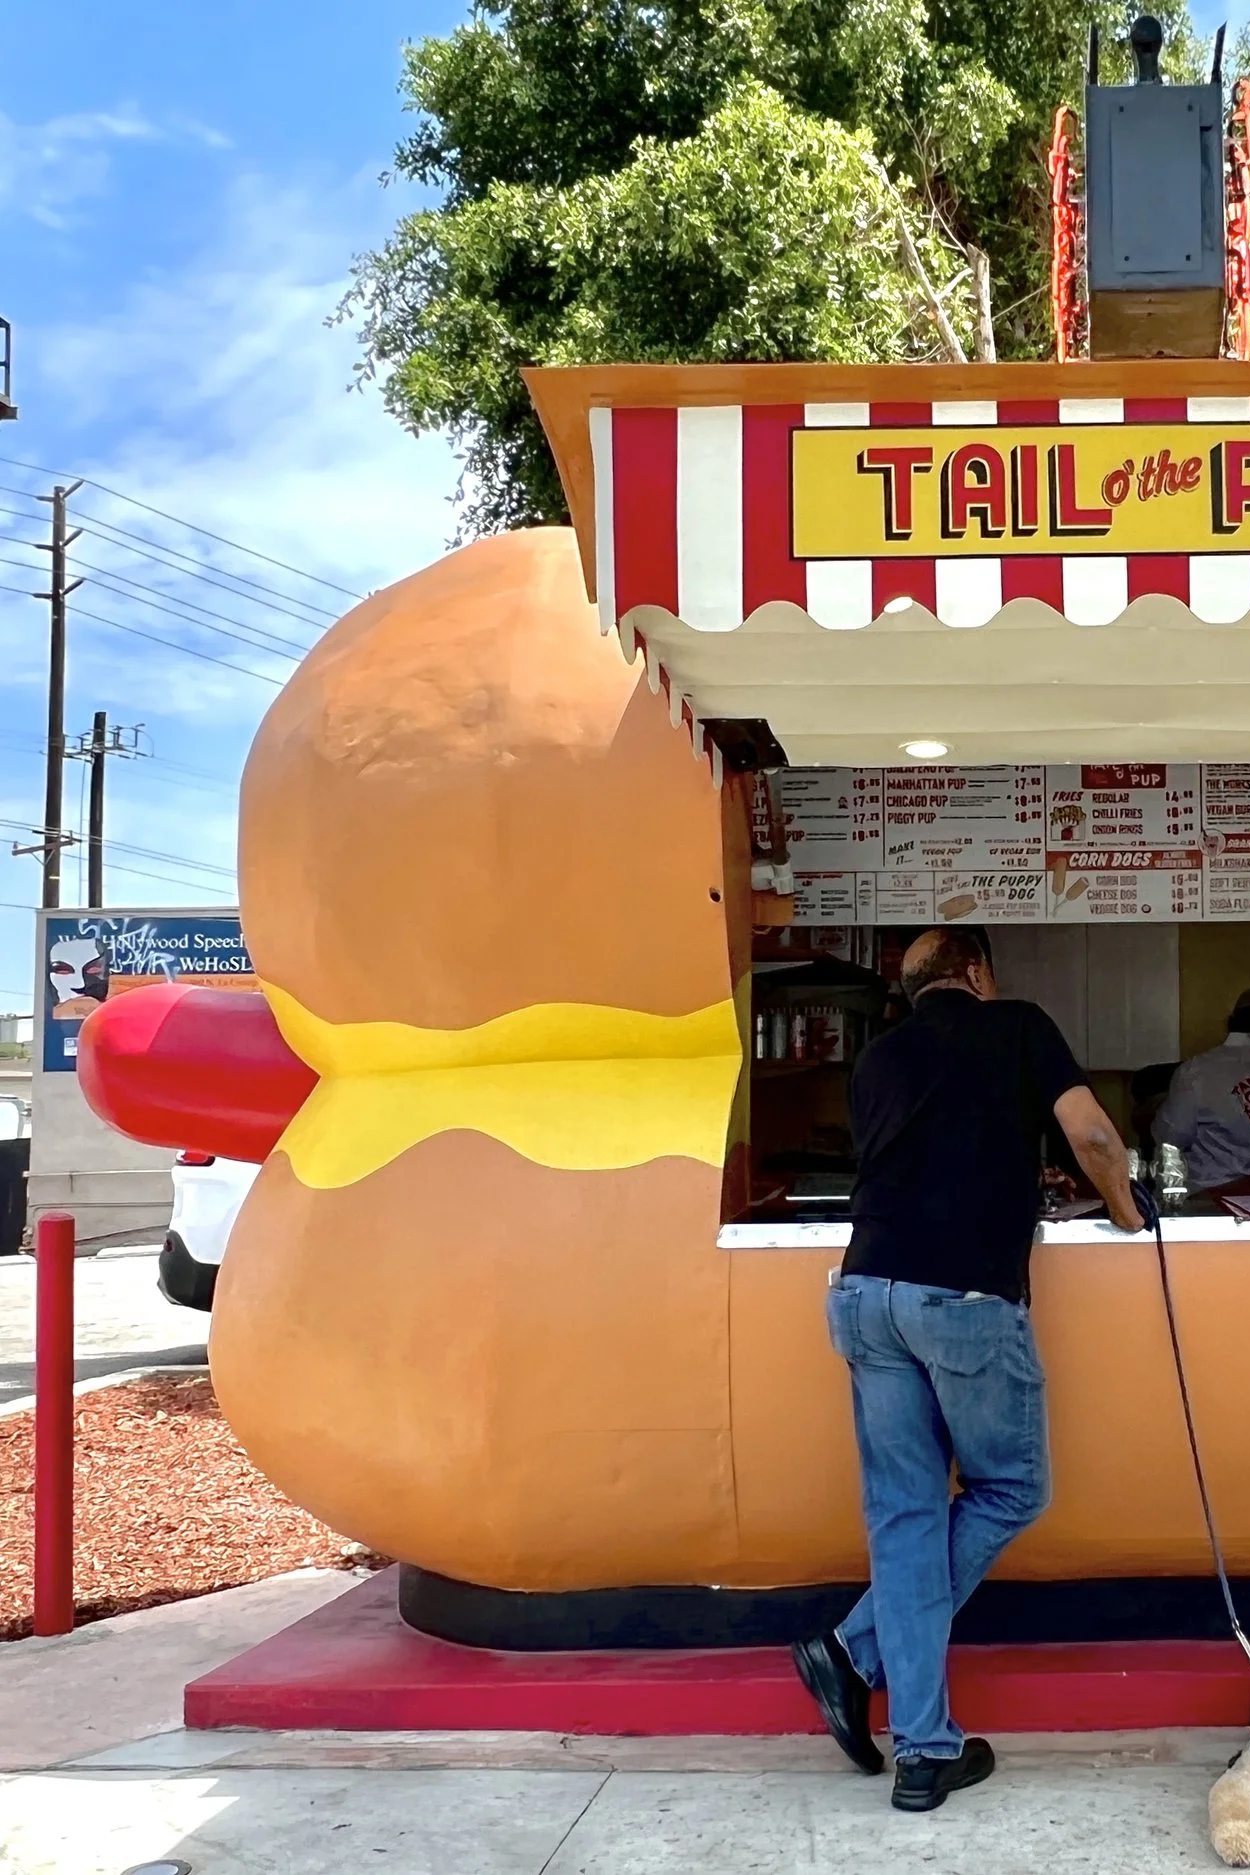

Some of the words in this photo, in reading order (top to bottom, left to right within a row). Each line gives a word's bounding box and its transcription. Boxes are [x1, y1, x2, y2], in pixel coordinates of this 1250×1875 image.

[857, 443, 1114, 540] TAIL
[1138, 449, 1203, 500] the
[886, 778, 946, 790] MANHATTAN
[949, 778, 967, 790] PUP
[1131, 774, 1161, 786] PUP
[886, 795, 929, 807] CHICAGO
[930, 795, 948, 807] PUP
[1053, 791, 1084, 802] FRIES
[887, 812, 916, 825] PIGGY
[918, 812, 936, 824] PUP
[1120, 808, 1143, 819] FRIES
[1069, 853, 1109, 867] CORN
[1111, 852, 1152, 867] DOGS
[972, 875, 996, 887] THE
[998, 874, 1043, 888] PUPPY
[1008, 888, 1036, 900] DOG
[1087, 889, 1118, 900] CHEESE
[1120, 889, 1138, 900] DOG
[1120, 904, 1138, 914] DOG
